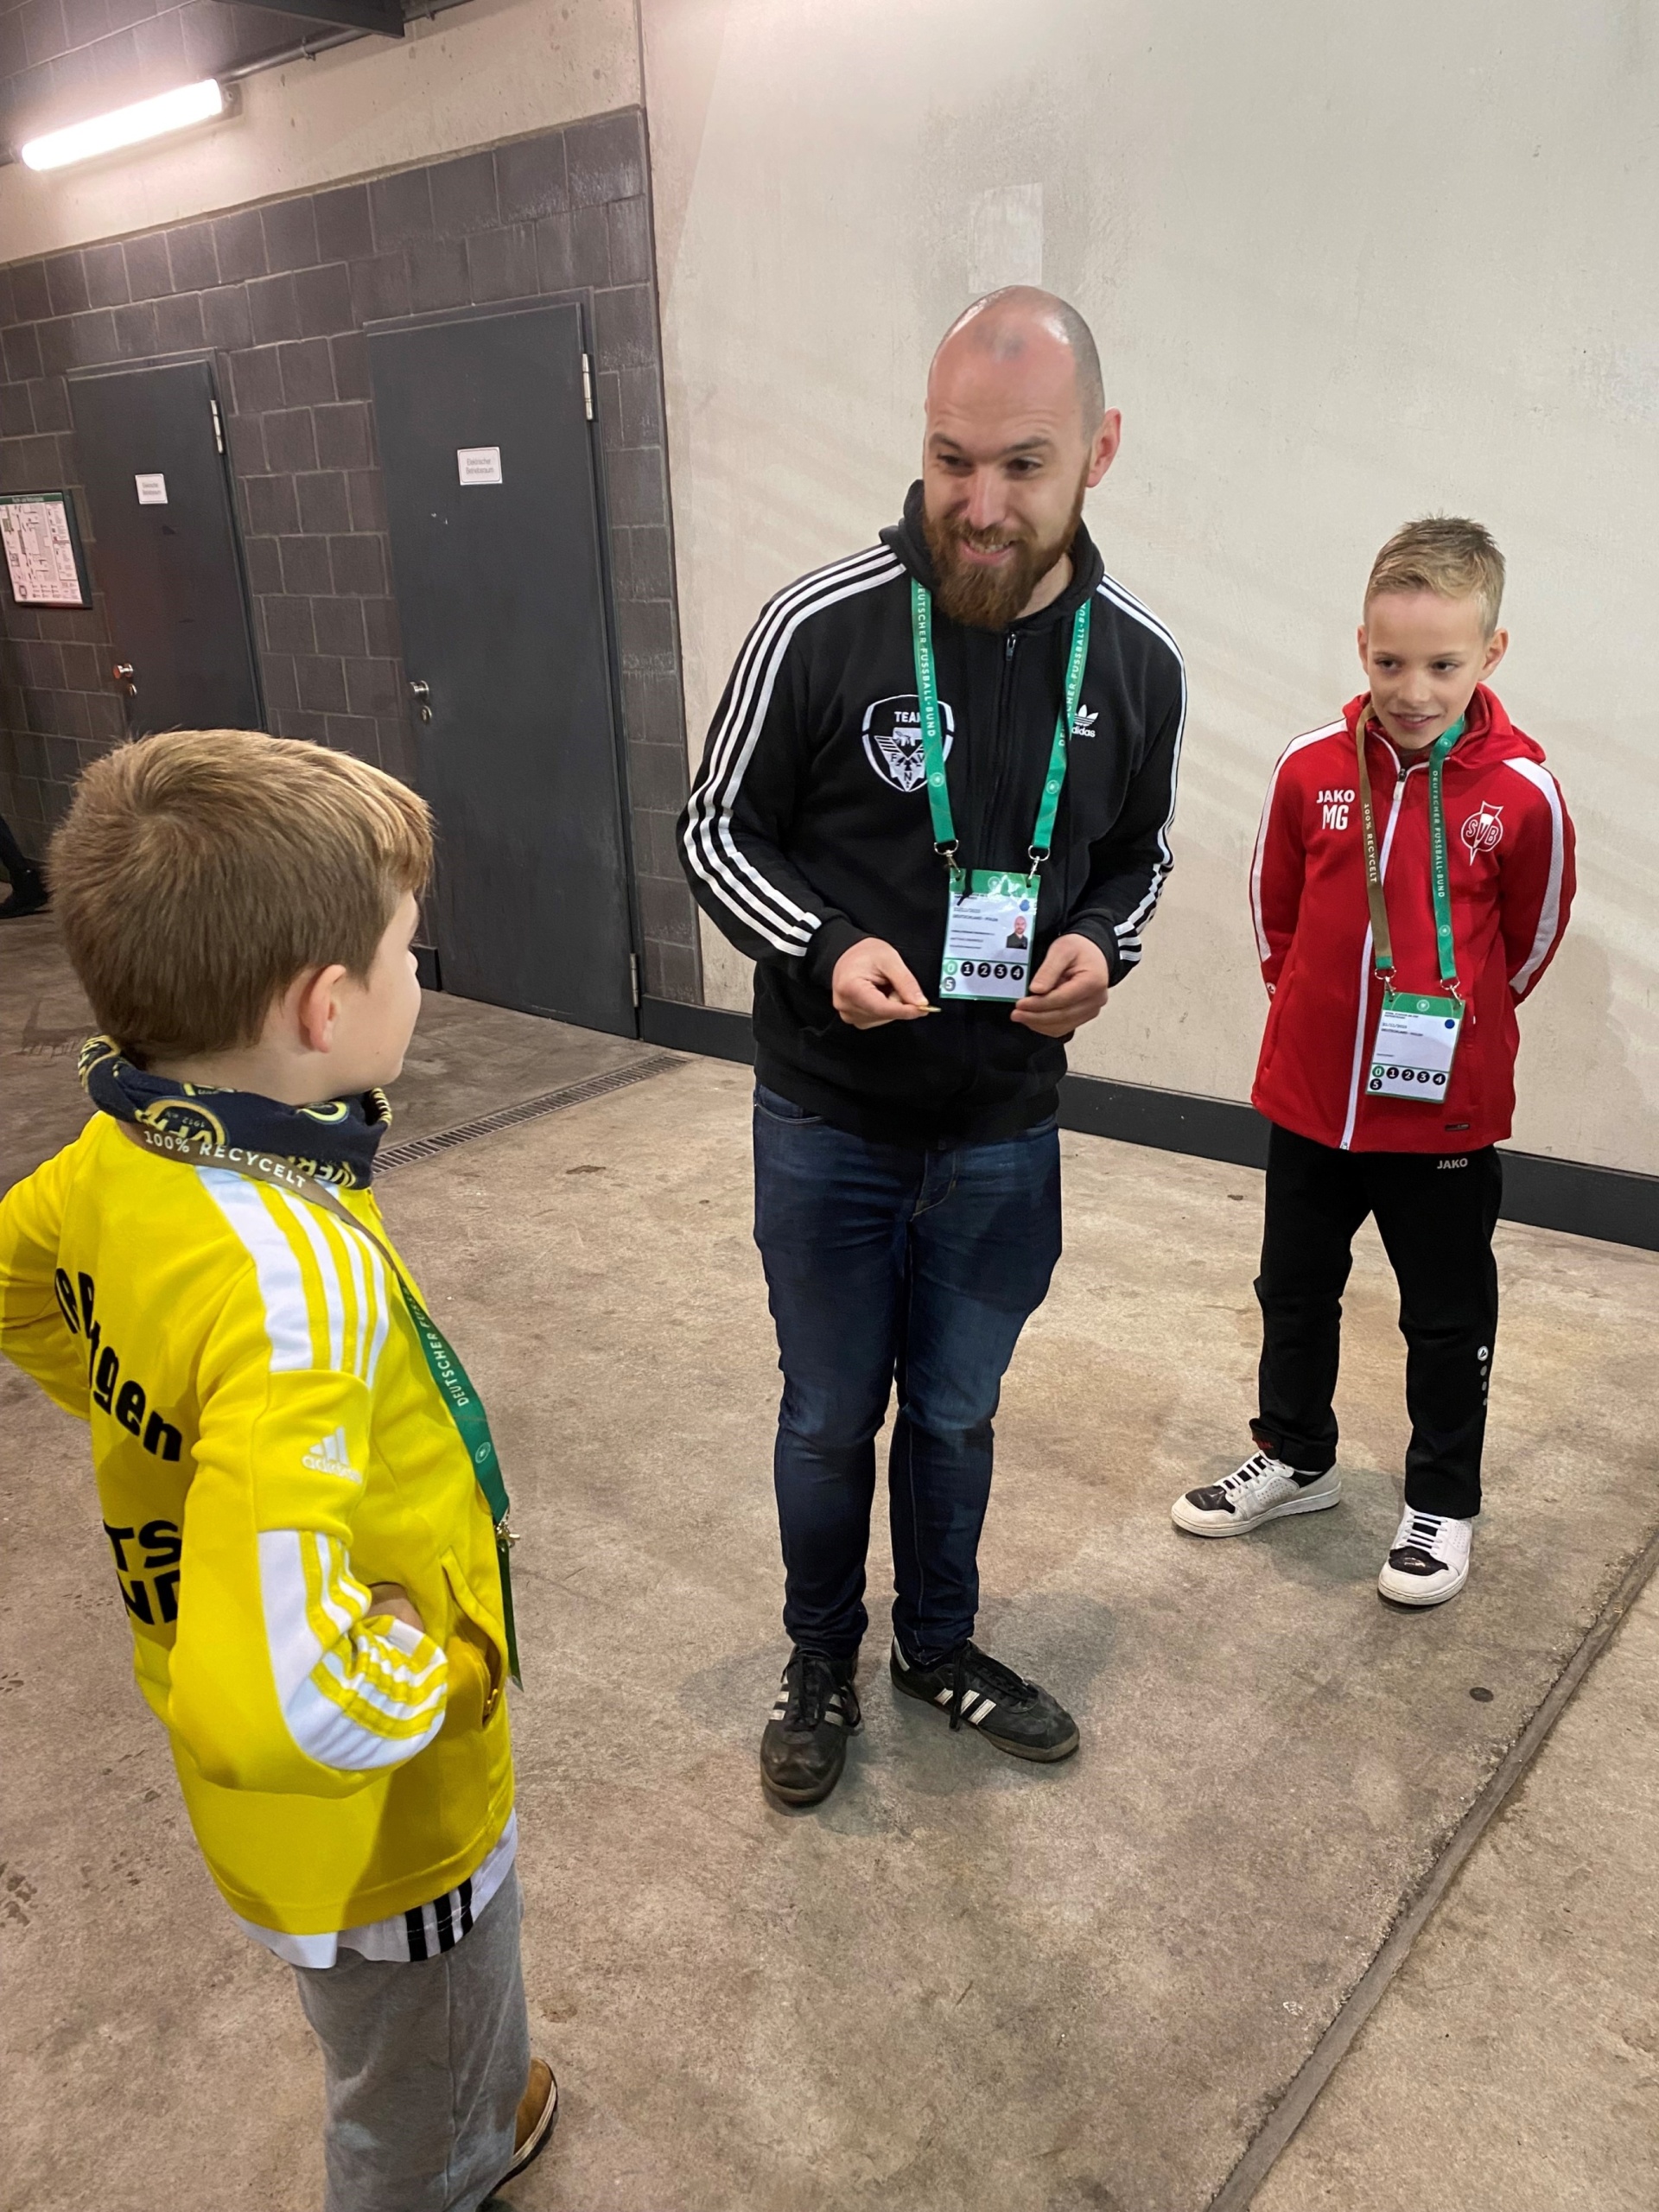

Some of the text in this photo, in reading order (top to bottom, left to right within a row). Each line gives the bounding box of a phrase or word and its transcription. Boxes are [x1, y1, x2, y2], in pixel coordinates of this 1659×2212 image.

[1071, 602, 1087, 679] FUSSBALL-BU
[1072, 726, 1096, 738] didas
[1316, 789, 1356, 804] JAKO
[1432, 771, 1440, 824] DEUTSCHER
[1322, 804, 1350, 830] MG
[1363, 804, 1377, 883] 100% RECYCELT
[947, 963, 1020, 978] 0 1 2 3 4
[945, 979, 952, 989] 5
[1389, 1069, 1395, 1077] 1
[1404, 1071, 1411, 1079] 2
[1420, 1072, 1427, 1081] 3
[1436, 1075, 1443, 1084] 4
[1373, 1080, 1379, 1089] 5
[145, 1130, 308, 1189] 100% RECYCELT
[1437, 1158, 1468, 1169] JAKO
[426, 1332, 470, 1408] DEUTSCHER
